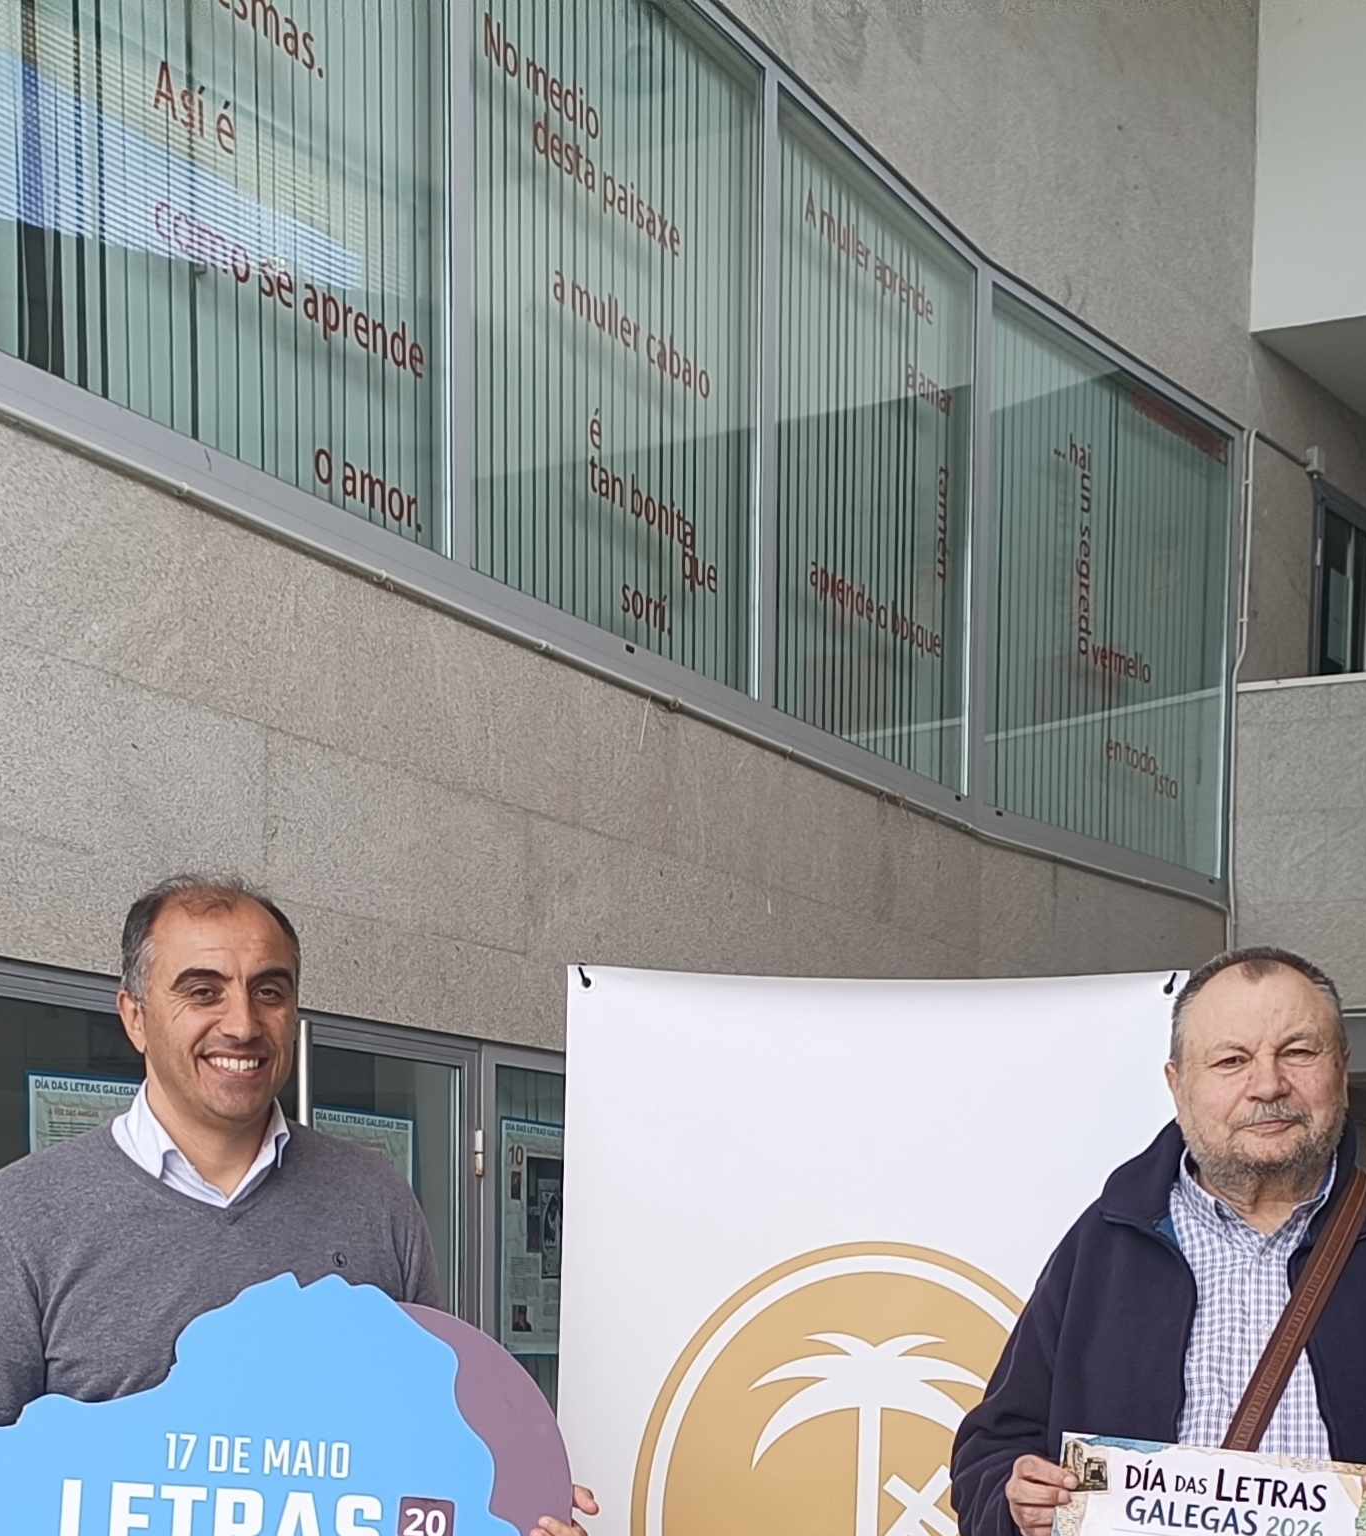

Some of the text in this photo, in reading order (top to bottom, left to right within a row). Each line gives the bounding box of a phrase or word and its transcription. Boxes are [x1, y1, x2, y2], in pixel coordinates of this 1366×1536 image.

[153, 60, 236, 155] Así é
[484, 11, 600, 140] No medio
[533, 111, 682, 257] desta paisaxe
[805, 186, 934, 326] A muller aprende
[259, 254, 295, 308] se
[302, 282, 425, 380] aprende
[552, 269, 711, 400] a muller cabalo
[589, 407, 603, 450] é
[314, 447, 424, 534] o amor.
[589, 455, 696, 550] tan bonita
[681, 548, 719, 594] que
[809, 560, 875, 624] aprende
[1075, 524, 1092, 656] segredo
[1092, 644, 1152, 684] vermello
[35, 1076, 49, 1090] DÍA
[51, 1080, 69, 1092] DAS
[70, 1081, 101, 1095] LETRAS
[507, 1144, 524, 1166] 10
[164, 1432, 352, 1480] 17 DE MAIO
[1124, 1459, 1329, 1513] DÍA DAS LETRAS
[1125, 1495, 1259, 1536] GALEGAS
